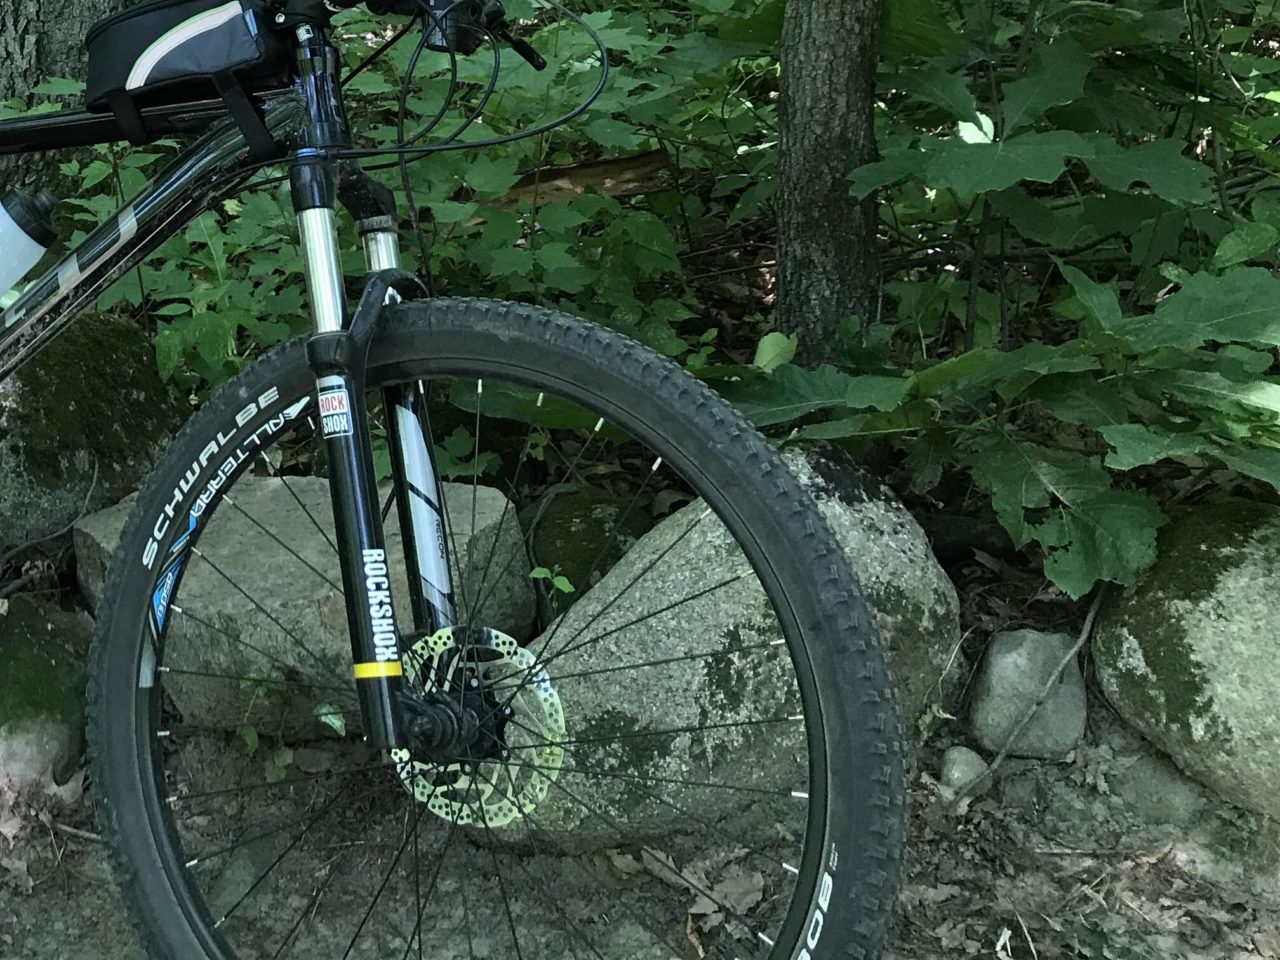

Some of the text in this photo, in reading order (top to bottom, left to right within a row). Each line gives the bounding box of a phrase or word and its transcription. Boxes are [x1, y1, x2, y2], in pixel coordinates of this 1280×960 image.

[320, 394, 345, 413] ROCK
[322, 414, 349, 434] SHOX
[142, 386, 279, 570] SCHWALBE
[189, 413, 285, 517] ALL TERRA
[434, 519, 446, 560] RECON
[362, 548, 398, 662] ROCKSHOX
